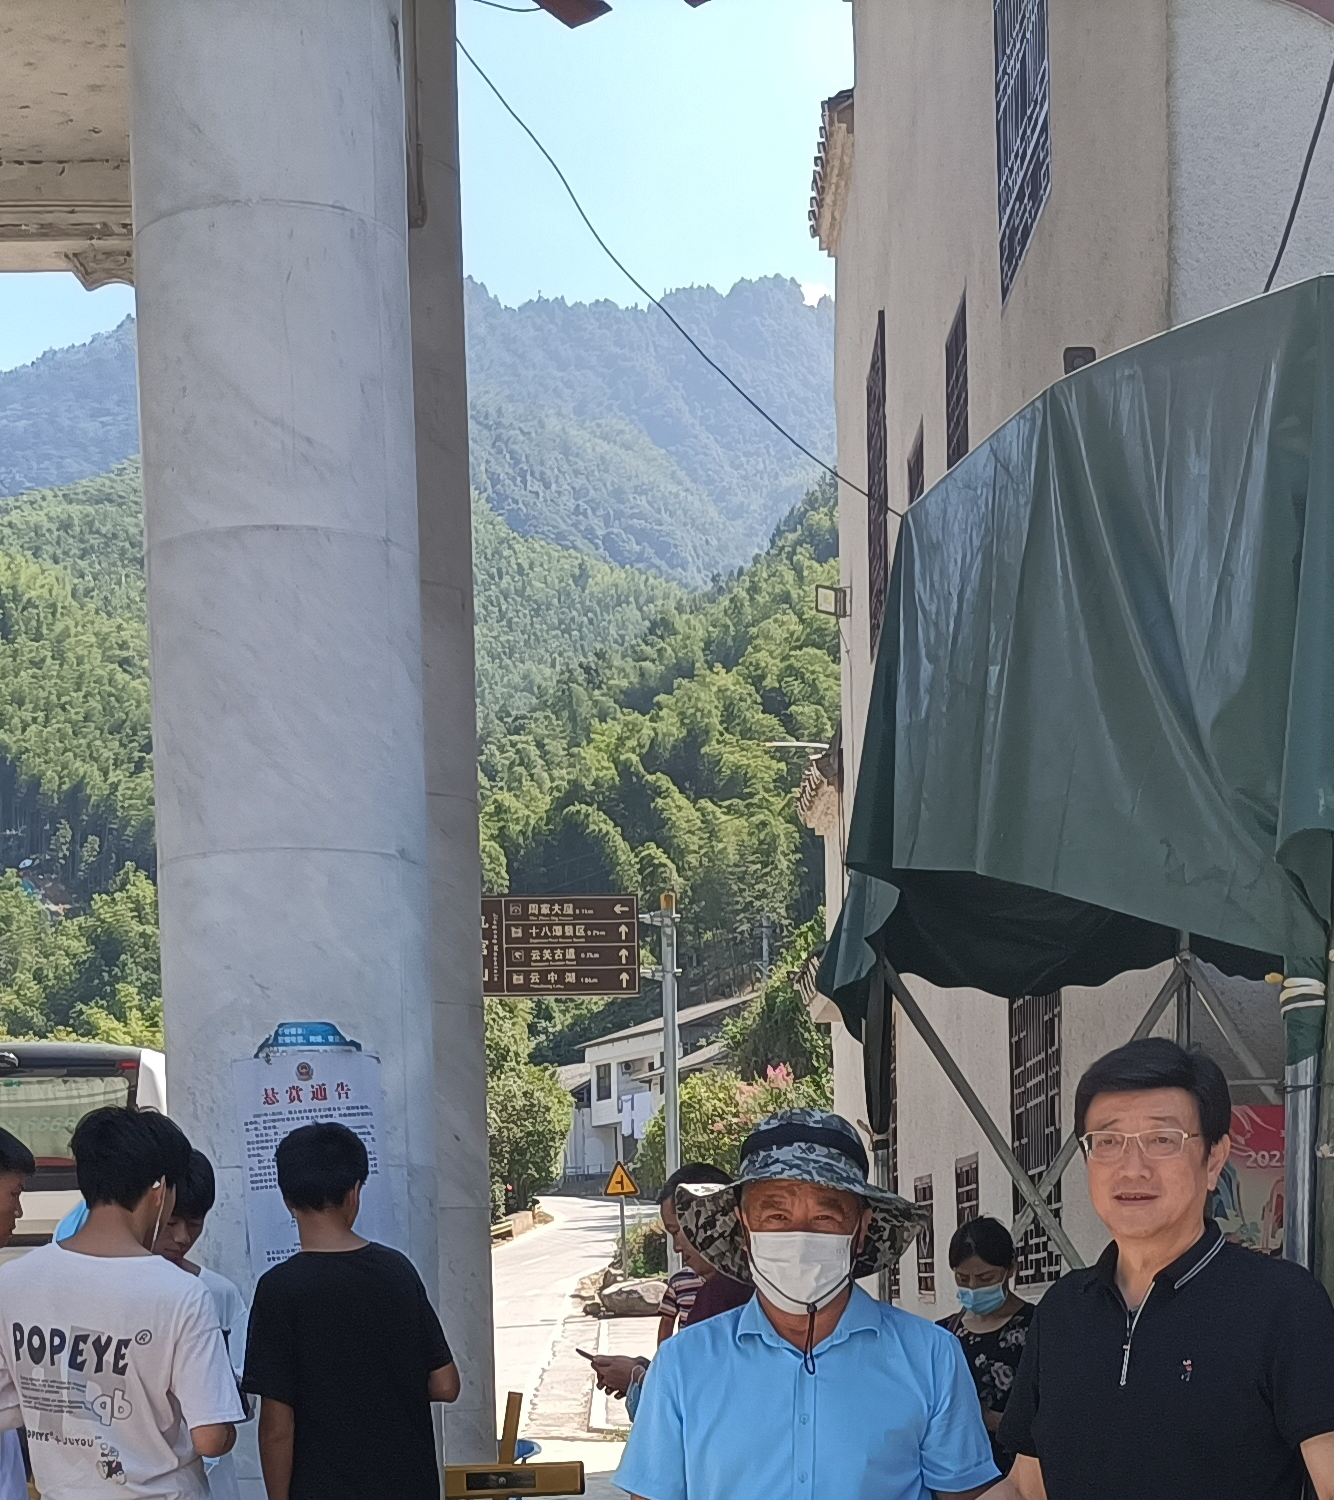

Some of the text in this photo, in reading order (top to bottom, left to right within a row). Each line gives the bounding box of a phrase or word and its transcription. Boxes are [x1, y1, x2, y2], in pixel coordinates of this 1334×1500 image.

[262, 1081, 352, 1105] 悬赏通告
[1246, 1150, 1285, 1169] 202
[12, 1322, 133, 1376] POPEYE
